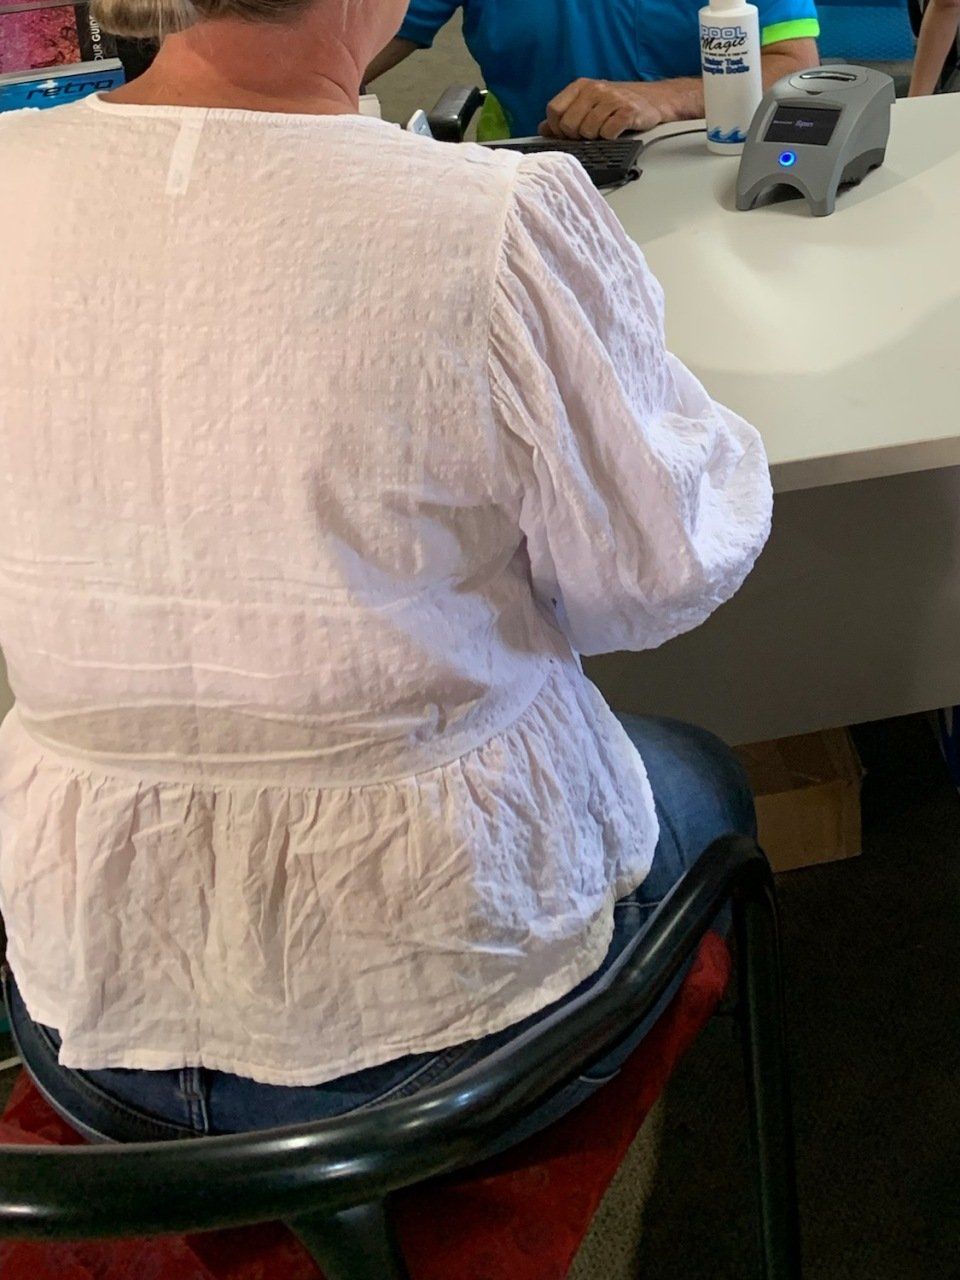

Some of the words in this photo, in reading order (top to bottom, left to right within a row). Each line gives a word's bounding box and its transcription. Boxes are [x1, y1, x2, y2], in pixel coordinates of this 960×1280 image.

[702, 24, 747, 40] POOL
[702, 36, 745, 52] Magic
[725, 57, 743, 66] Test
[726, 65, 749, 74] Bottle
[26, 78, 114, 101] retro
